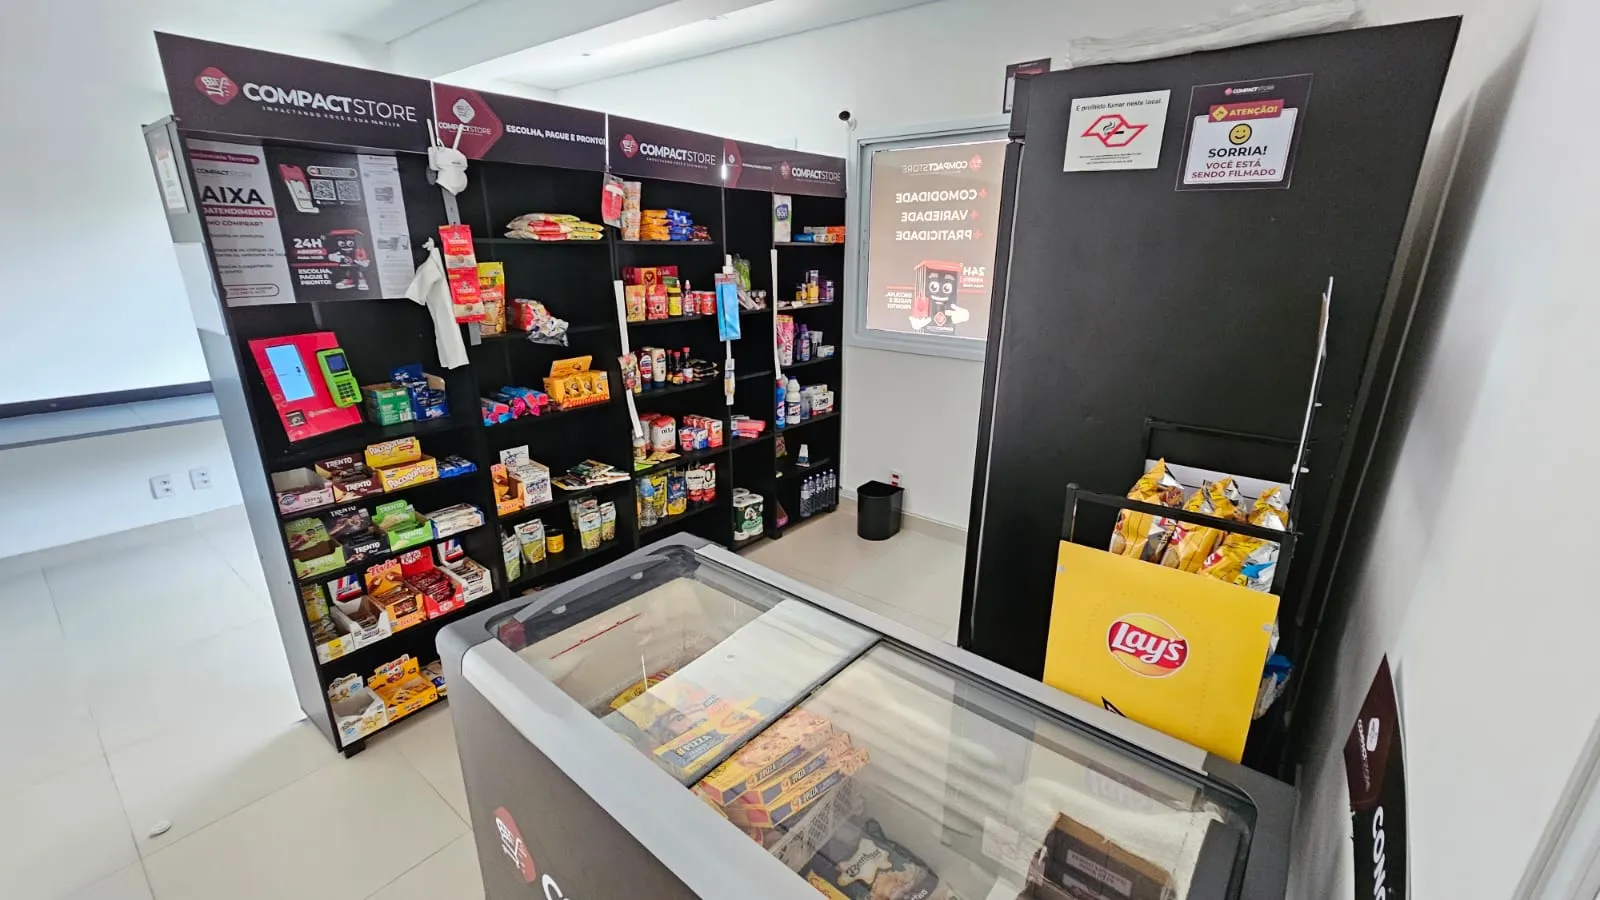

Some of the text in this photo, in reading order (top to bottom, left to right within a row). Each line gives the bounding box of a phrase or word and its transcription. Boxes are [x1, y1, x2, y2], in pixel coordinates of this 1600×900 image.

[243, 83, 417, 122] COMPACTSTORE
[1229, 105, 1278, 117] ATENÇÃO!
[506, 124, 544, 138] ESCOLHA,
[545, 130, 570, 142] PAGUE
[570, 134, 576, 142] E
[639, 143, 717, 166] COMPACTSTORE
[1208, 146, 1268, 158] SORRIA!
[1206, 158, 1261, 170] VOCÊ ESTÁ
[791, 167, 840, 181] COMPACTSTORE
[1192, 169, 1276, 179] SENDO FILMADO
[293, 238, 323, 248] 24H
[325, 457, 353, 469] TRENTO
[345, 480, 372, 492] TRENTO
[330, 505, 357, 517] TRENTO
[354, 542, 380, 554] TRENTO
[1111, 622, 1185, 663] Lay's
